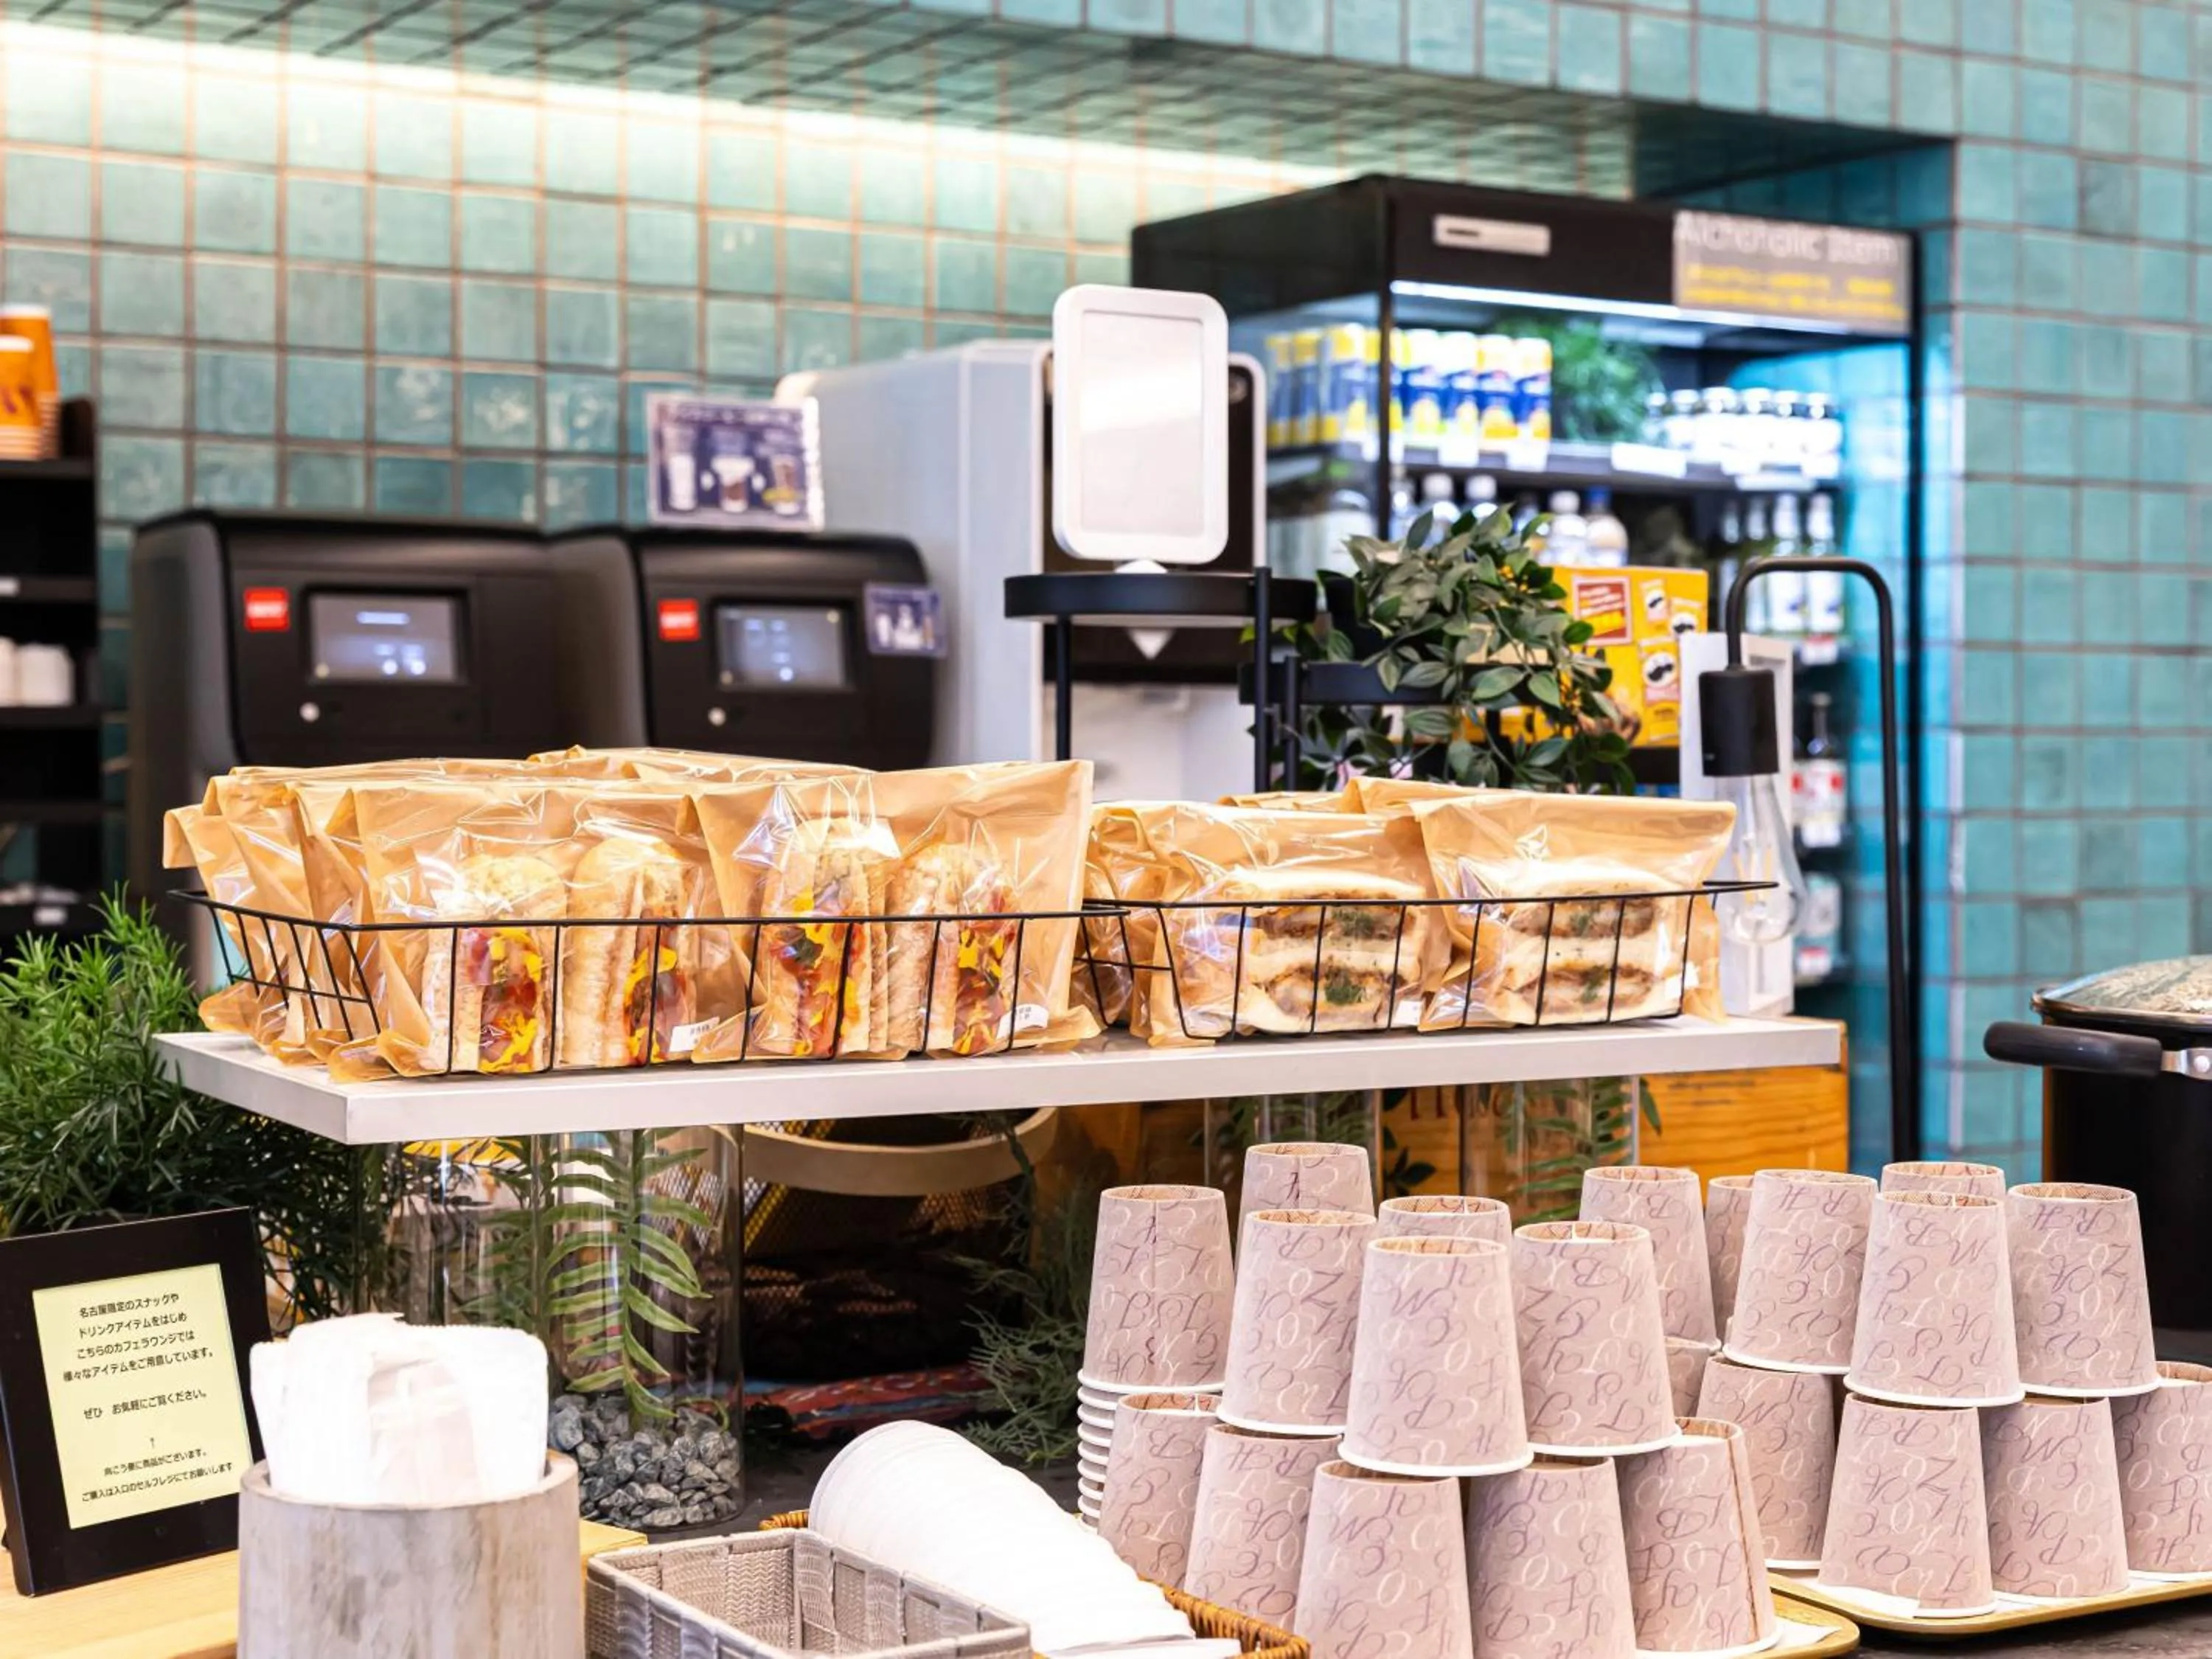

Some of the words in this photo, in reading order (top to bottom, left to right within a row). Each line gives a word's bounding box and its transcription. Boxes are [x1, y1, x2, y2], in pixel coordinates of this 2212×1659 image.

[79, 1293, 179, 1318] 名古屋限定のスナックや
[79, 1312, 187, 1339] ドリンクアイテムをはじめ
[77, 1330, 195, 1359] こちらのカフェラウンジでは
[63, 1347, 213, 1382] 様々なアイテムをご用意しています。
[83, 1407, 102, 1419] ぜひ
[111, 1389, 206, 1414] お気軽にご覧ください。
